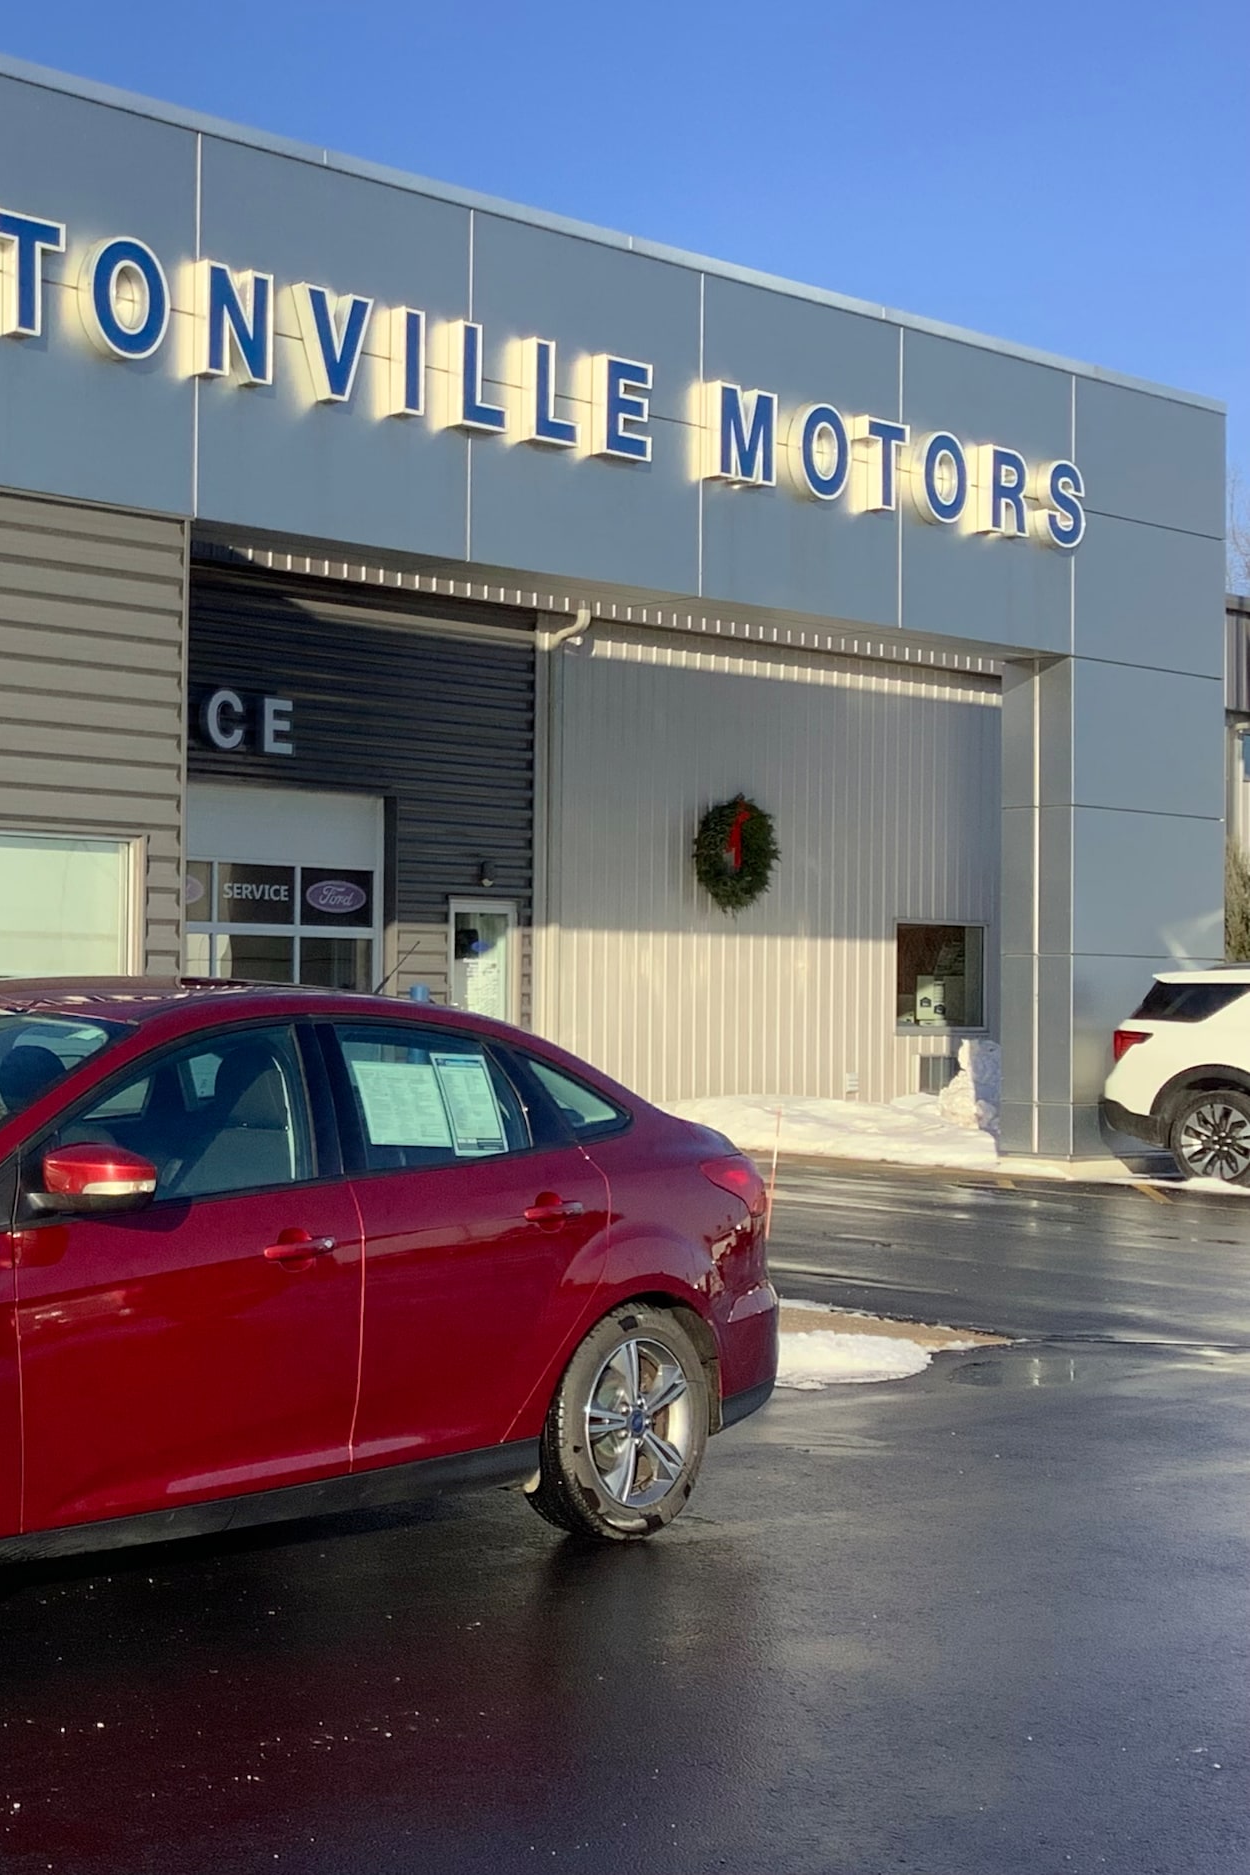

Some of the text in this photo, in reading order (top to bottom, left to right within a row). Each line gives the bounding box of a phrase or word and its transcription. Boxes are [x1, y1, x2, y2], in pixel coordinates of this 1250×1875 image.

[705, 379, 1087, 549] MOTORS
[222, 882, 290, 901] SERVICE
[318, 885, 355, 907] Ford
